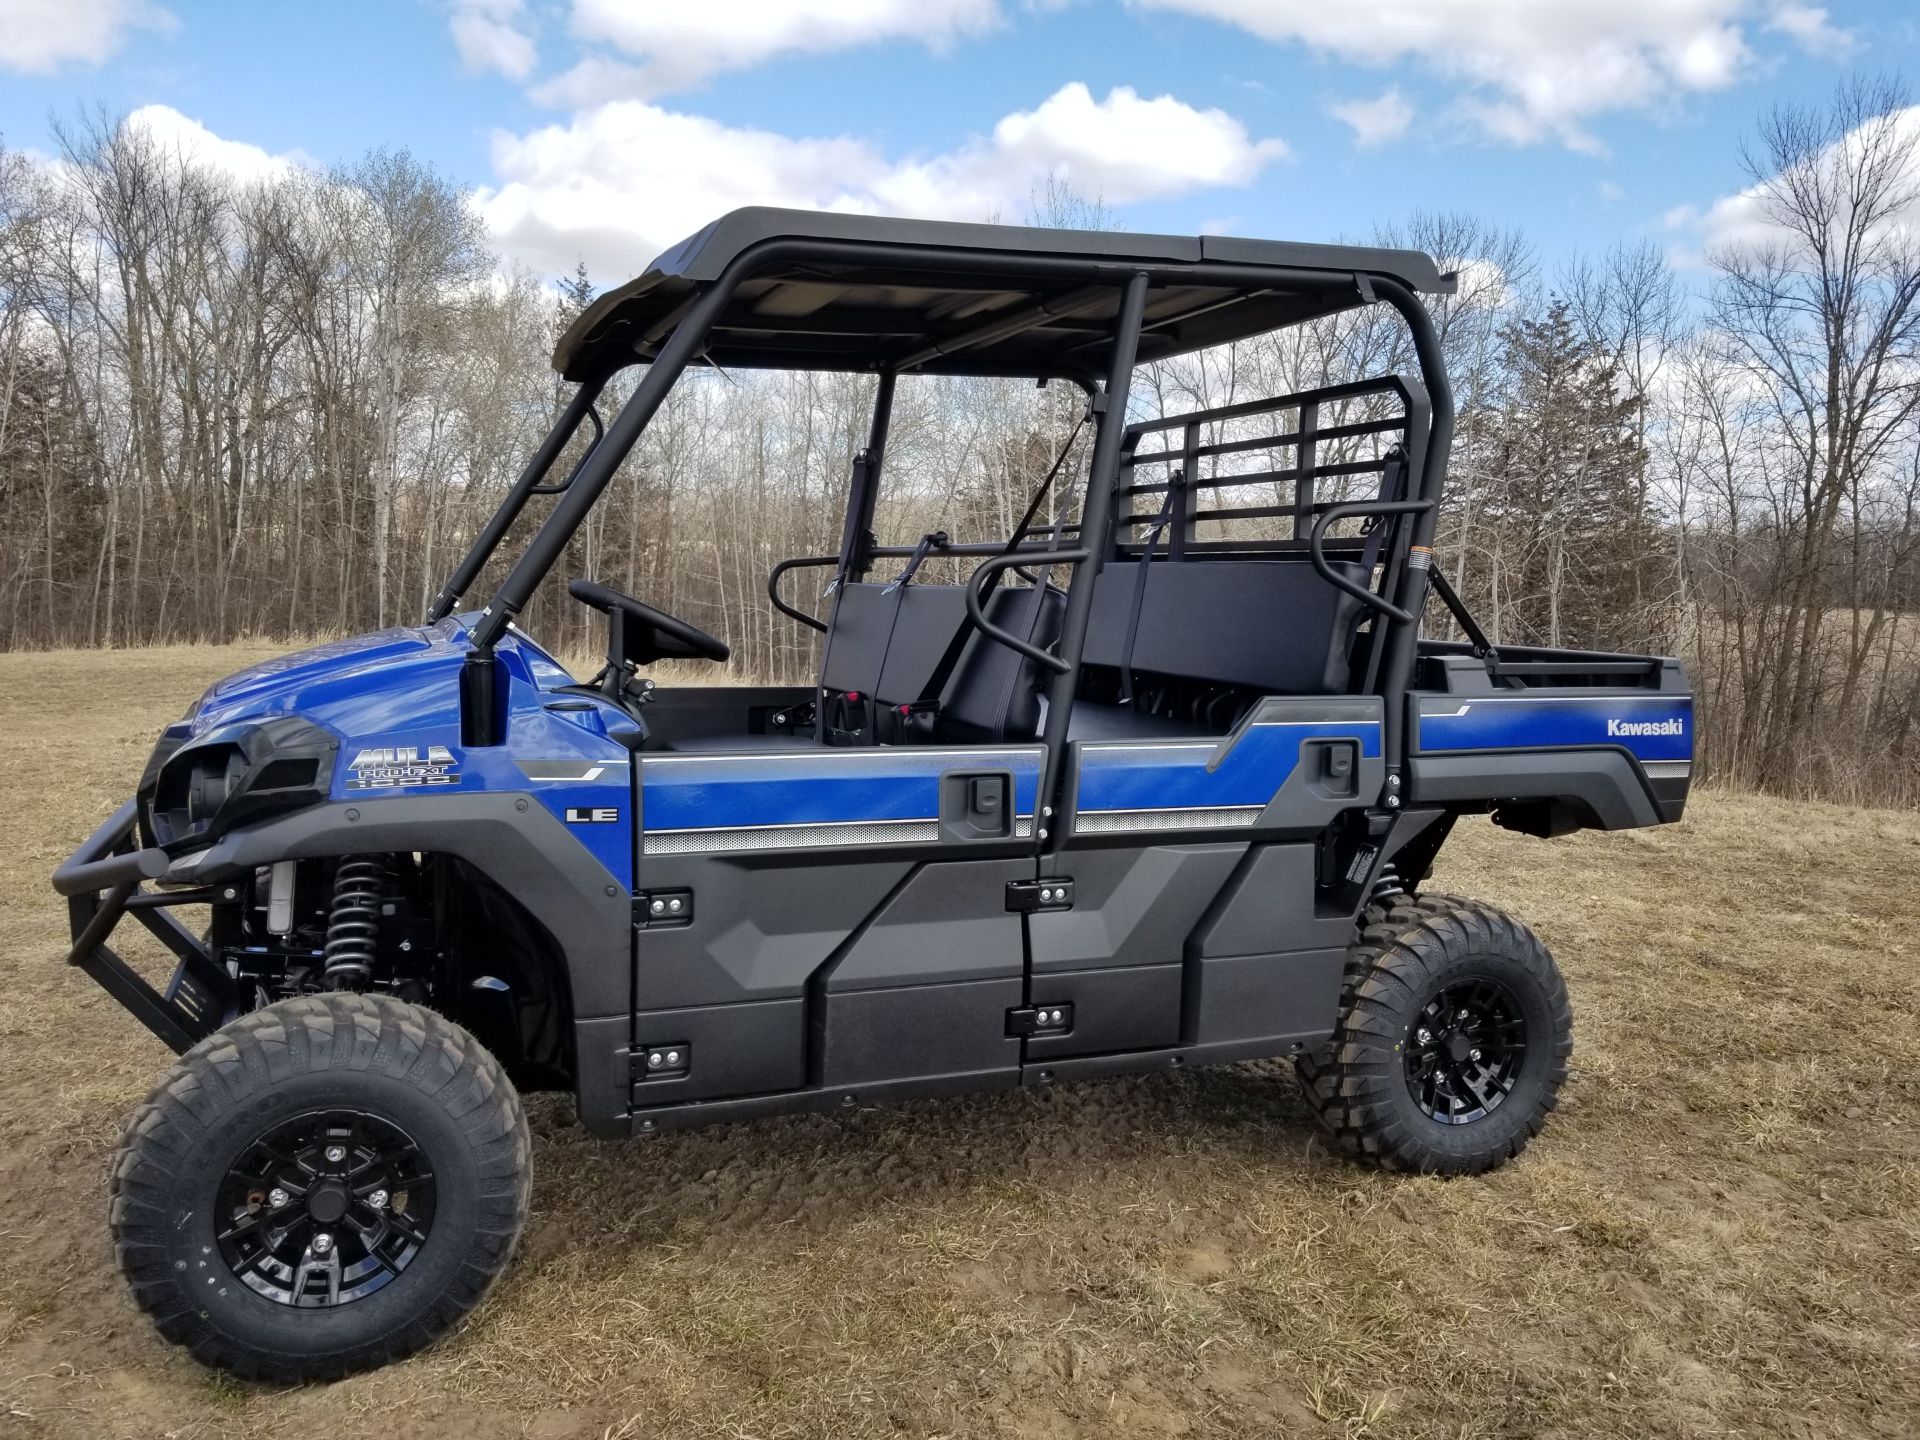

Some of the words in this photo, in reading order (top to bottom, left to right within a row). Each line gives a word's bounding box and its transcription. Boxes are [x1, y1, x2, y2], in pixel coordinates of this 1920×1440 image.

[1607, 718, 1683, 736] Kawasaki
[348, 746, 458, 770] MULE
[566, 809, 618, 822] LE
